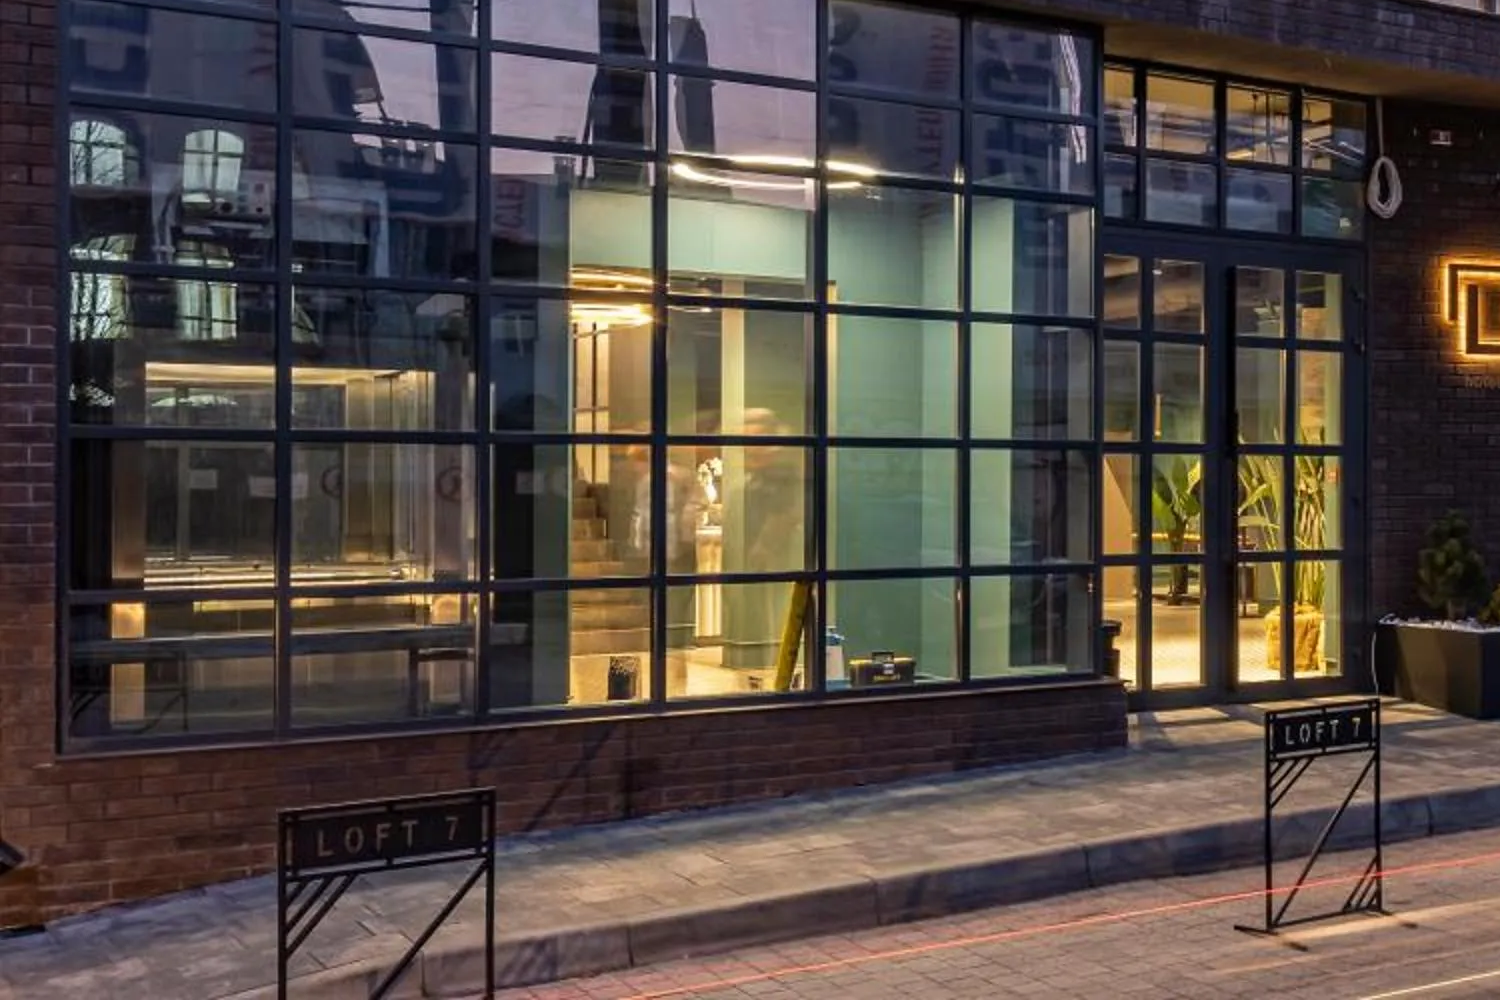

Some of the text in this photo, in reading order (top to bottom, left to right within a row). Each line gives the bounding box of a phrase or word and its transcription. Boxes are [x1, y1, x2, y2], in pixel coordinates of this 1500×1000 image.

[1285, 716, 1361, 745] LOFT 7
[316, 816, 459, 857] LOFT 7
